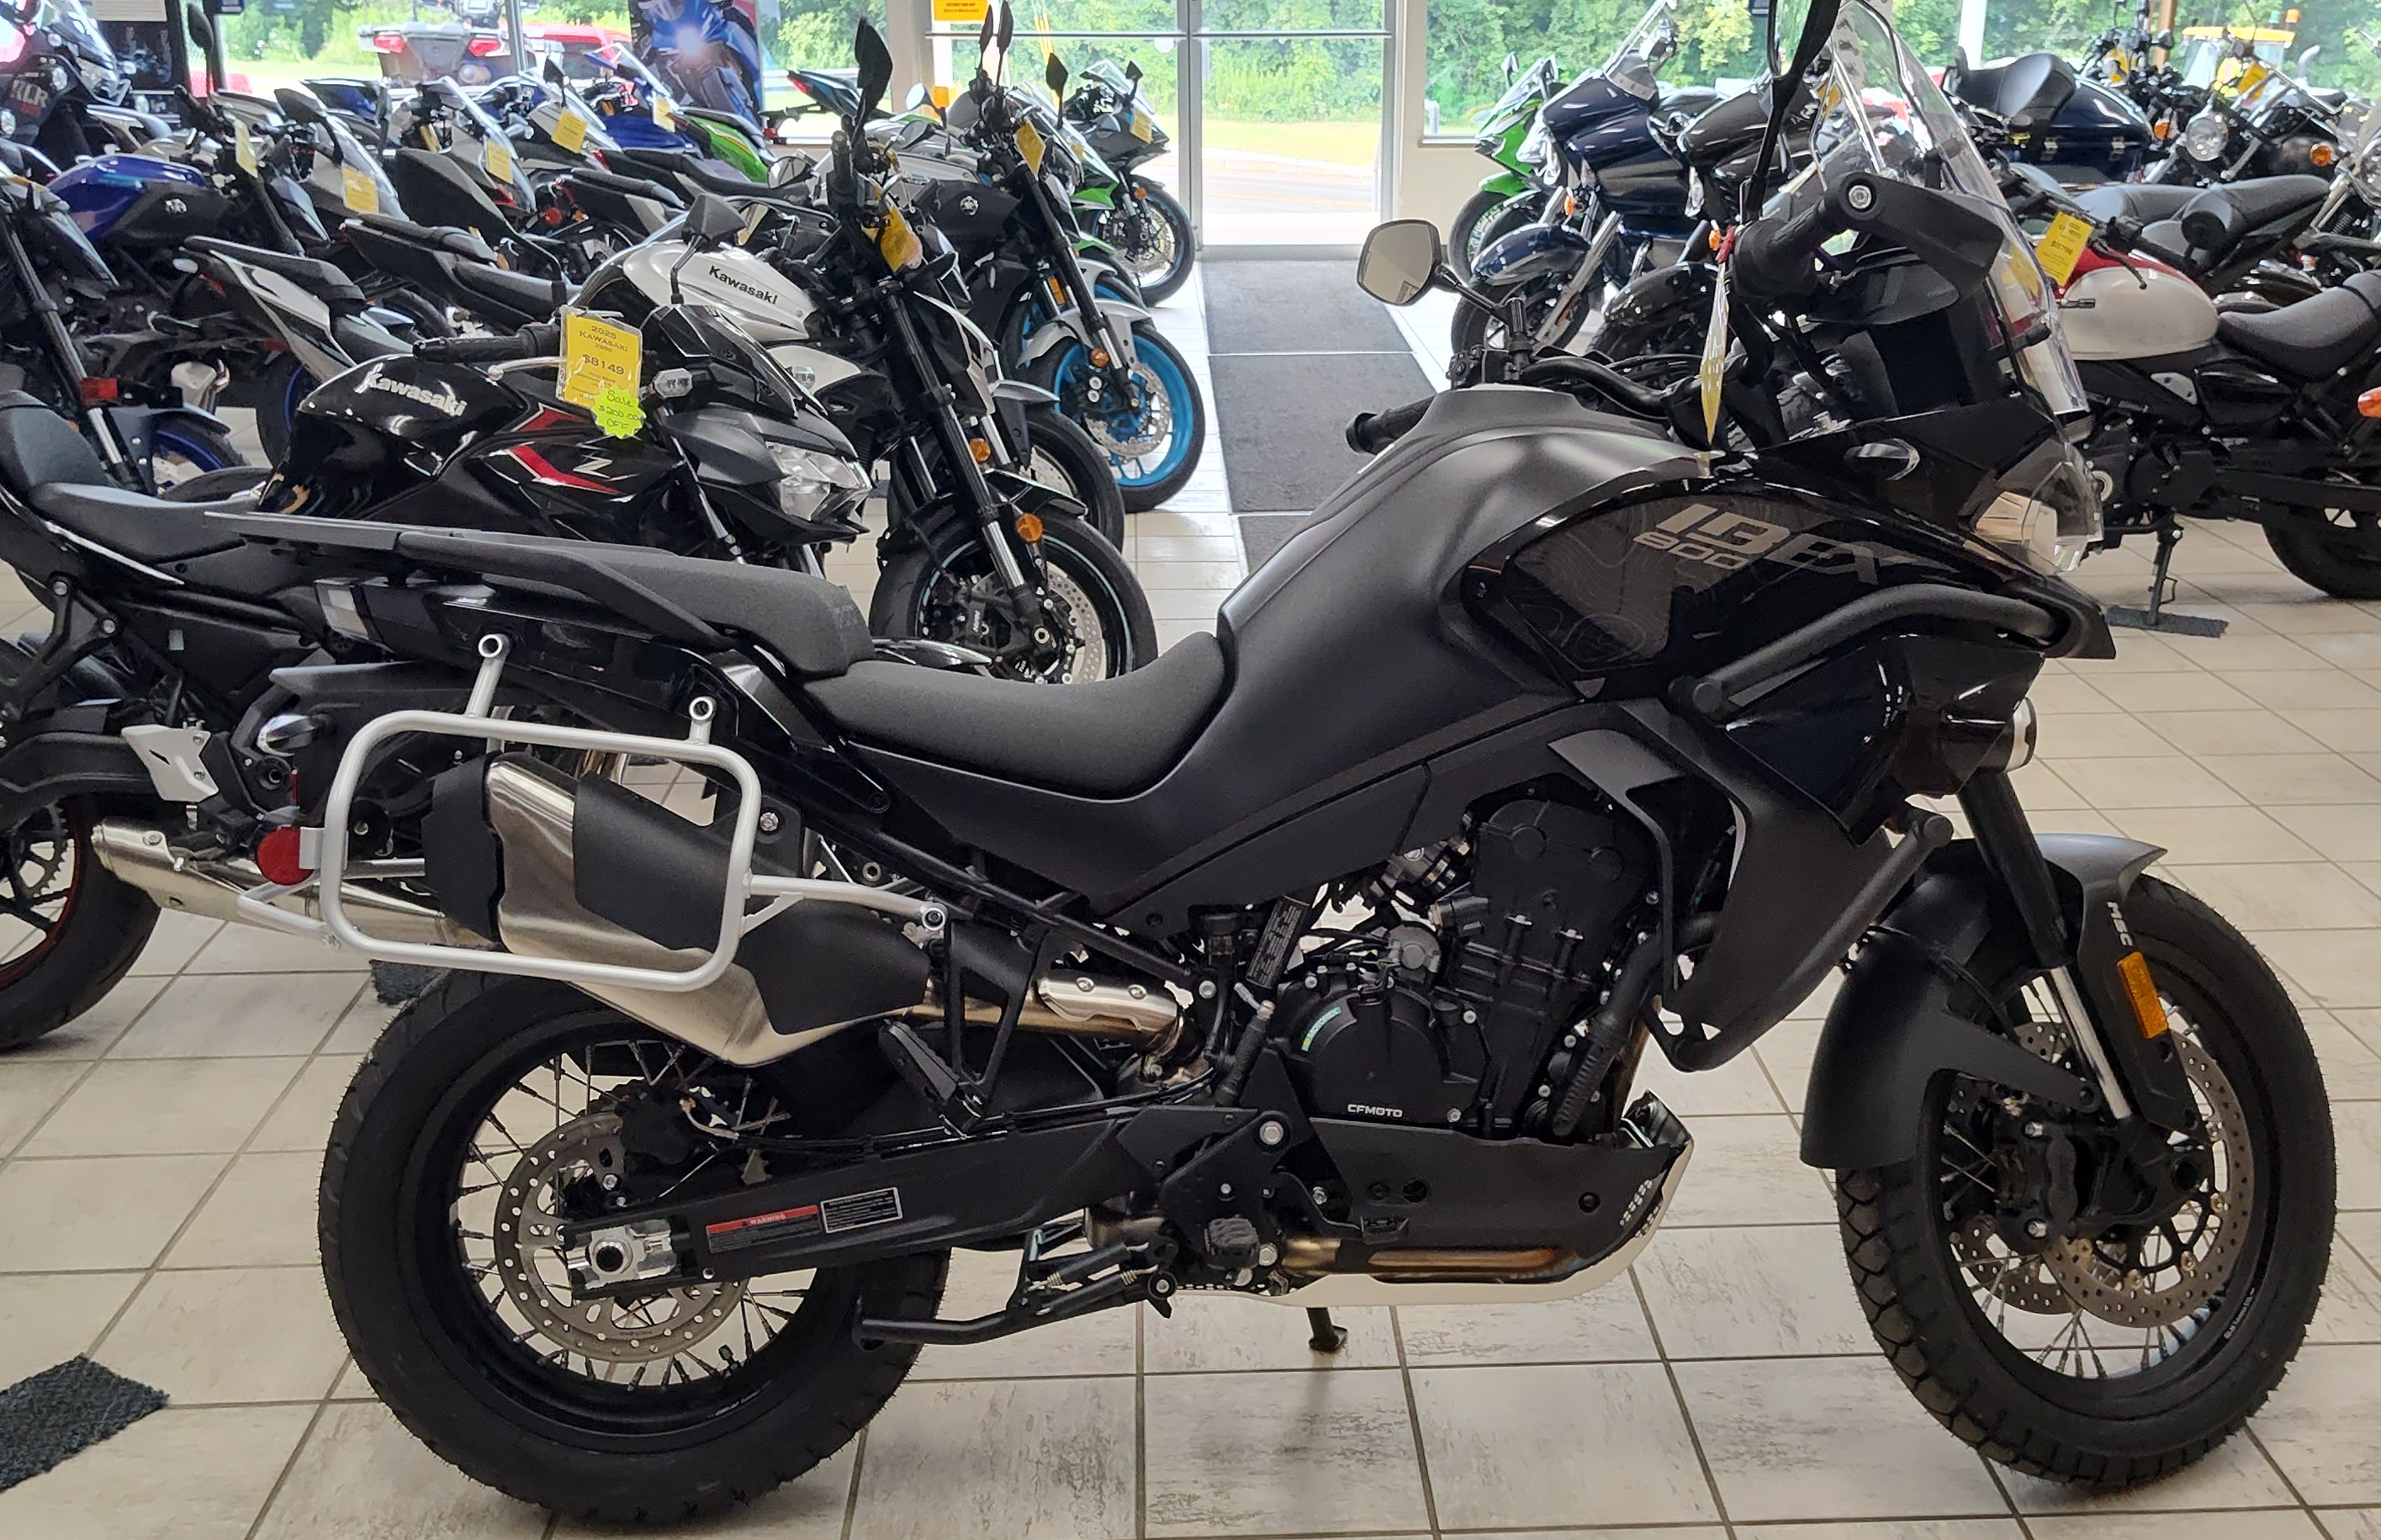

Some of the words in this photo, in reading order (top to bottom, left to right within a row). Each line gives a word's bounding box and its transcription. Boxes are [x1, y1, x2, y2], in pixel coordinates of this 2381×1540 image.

[708, 265, 779, 305] Kawasaki
[579, 330, 628, 352] KAWASAKI
[591, 325, 617, 340] 2025
[582, 354, 624, 374] $8149
[353, 362, 468, 417] Kawasaki
[606, 389, 634, 408] Sale
[606, 418, 630, 431] OFF
[1632, 530, 1749, 571] 800
[1347, 1103, 1404, 1118] CFMOTO
[749, 1212, 786, 1225] WARNING
